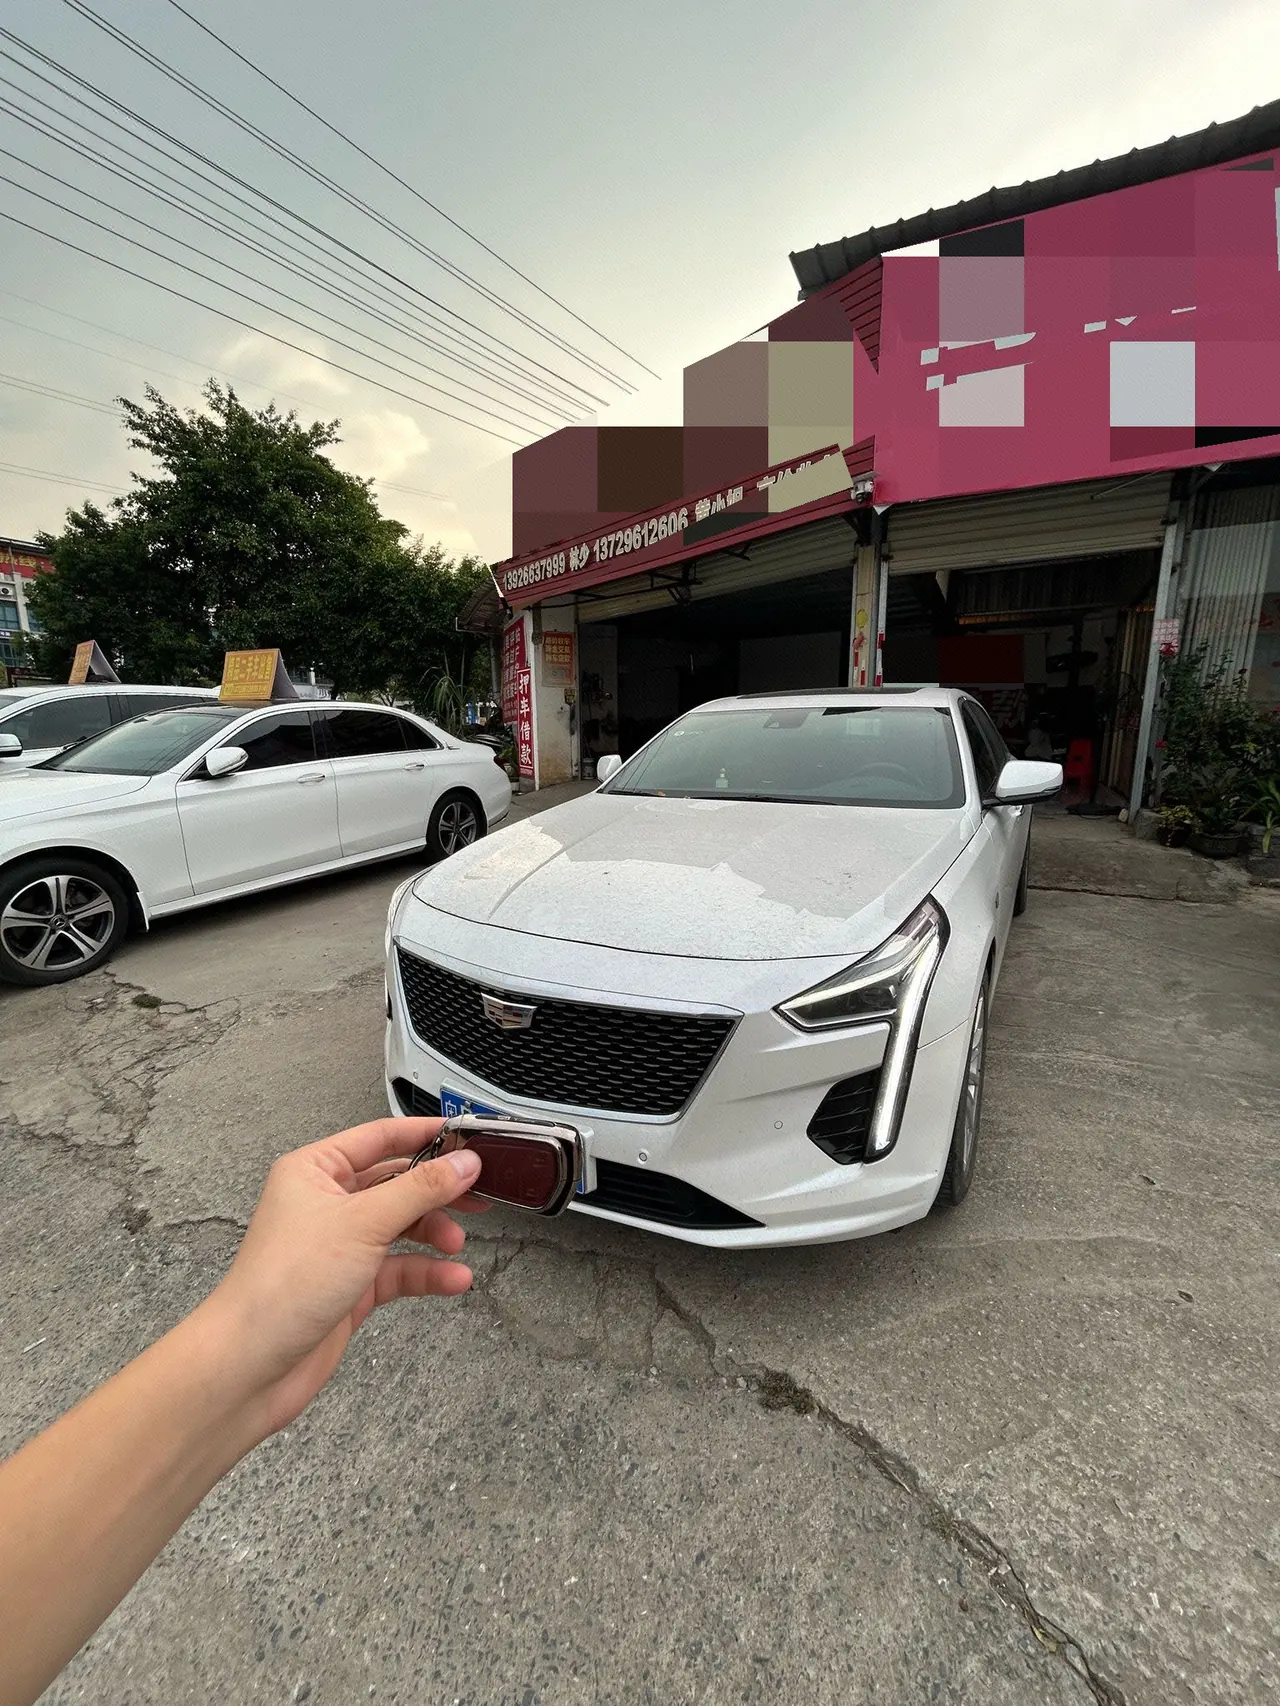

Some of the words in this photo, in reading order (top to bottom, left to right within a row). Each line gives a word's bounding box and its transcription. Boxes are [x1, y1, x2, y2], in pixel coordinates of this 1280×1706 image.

[503, 552, 566, 591] 13926637999
[593, 507, 689, 562] 13729612606
[519, 673, 532, 765] 押车借款
